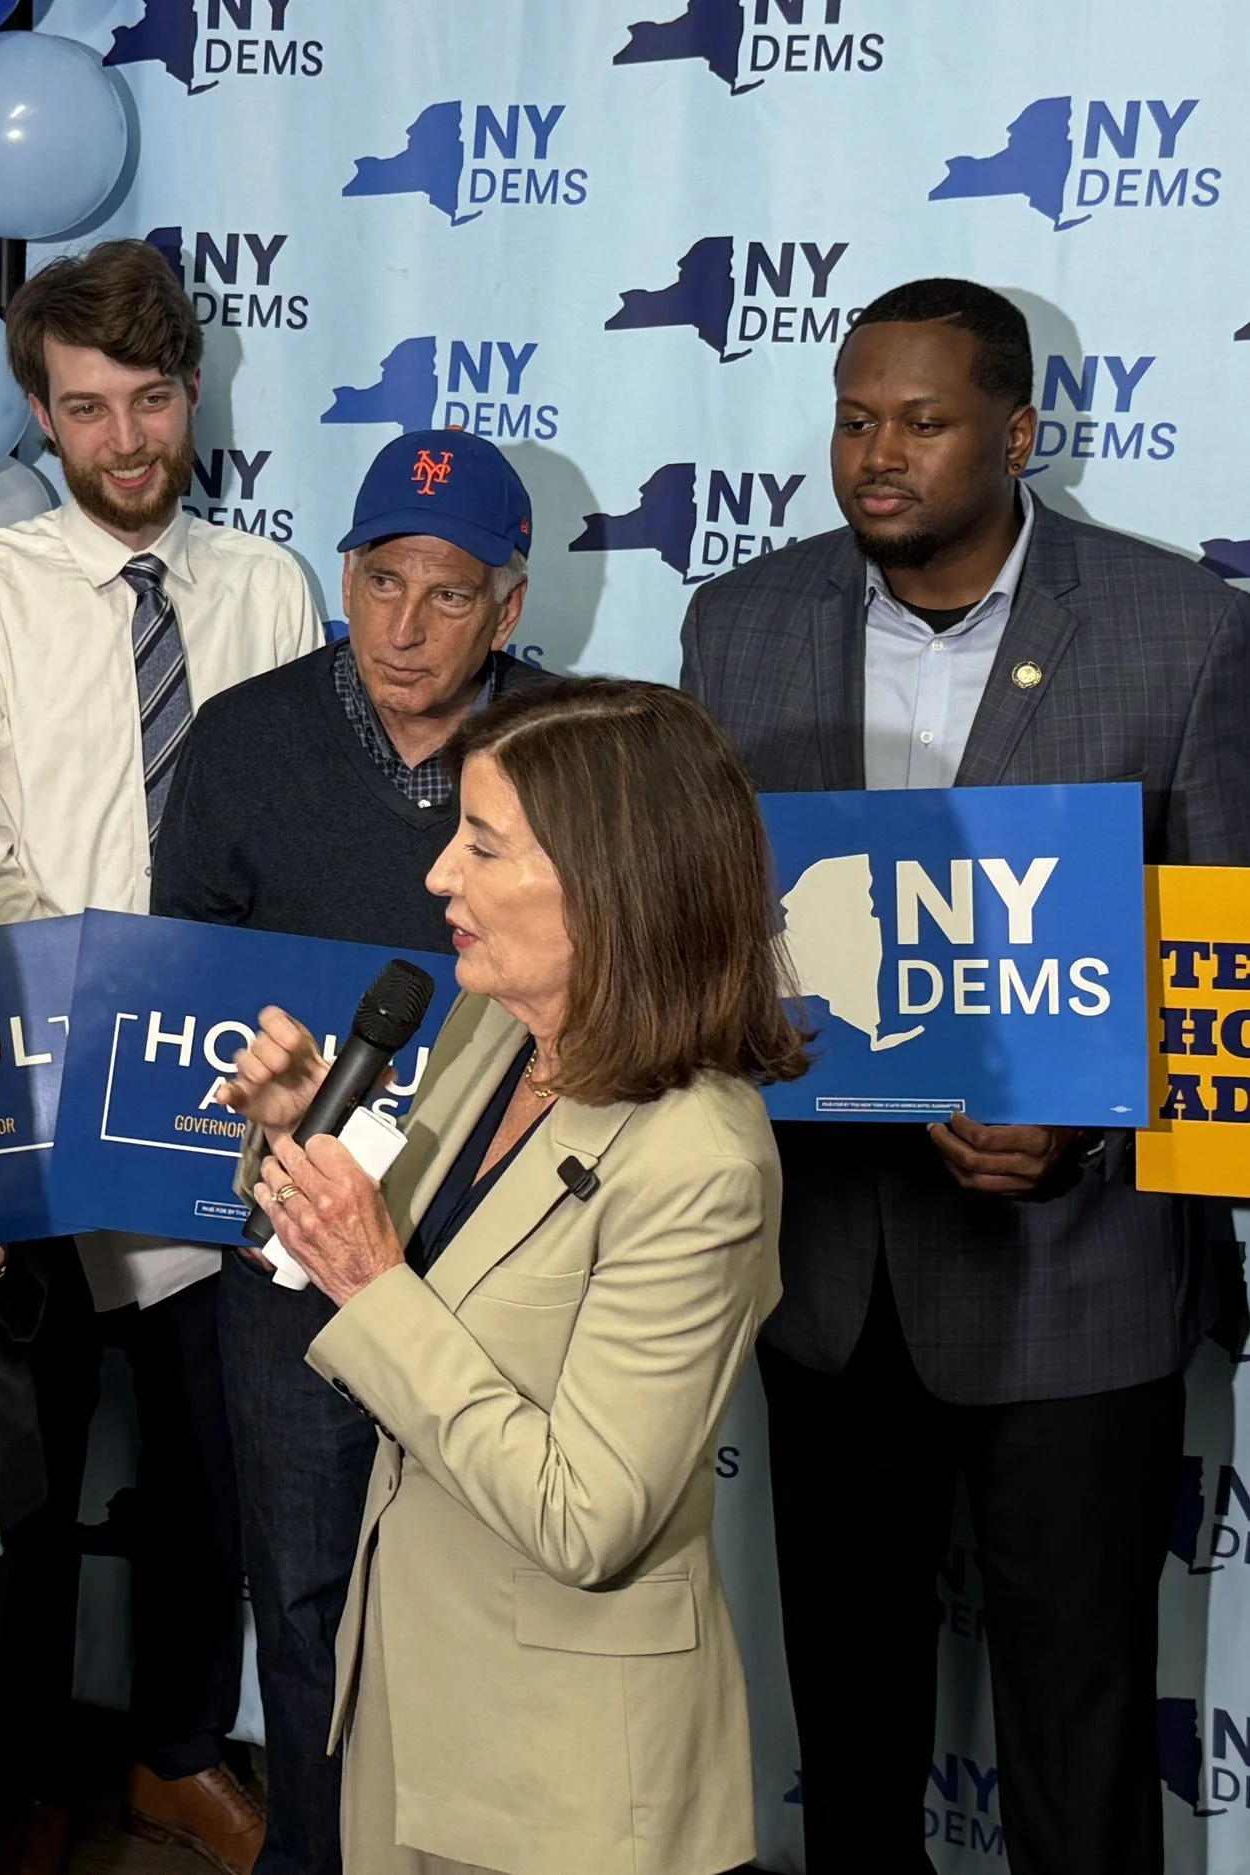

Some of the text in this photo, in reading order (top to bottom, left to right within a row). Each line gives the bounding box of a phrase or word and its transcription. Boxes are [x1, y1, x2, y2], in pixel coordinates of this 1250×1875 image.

[205, 38, 323, 77] DEMS
[750, 33, 885, 73] DEMS
[472, 105, 566, 160] NY
[1082, 99, 1200, 160] NY
[469, 168, 588, 206] DEMS
[1076, 168, 1222, 208] DEMS
[193, 231, 288, 286] NY
[744, 241, 850, 298] NY
[192, 291, 309, 330] DEMS
[447, 340, 539, 395] NY
[1041, 355, 1157, 413] NY
[444, 401, 559, 440] DEMS
[1034, 420, 1177, 460] DEMS
[180, 449, 272, 500] NY
[411, 450, 453, 495] NY
[705, 469, 807, 527] NY
[702, 530, 797, 568] DE
[896, 857, 1059, 945] NY
[897, 957, 1111, 1017] DEMS
[174, 1114, 247, 1139] GOVERNOR
[925, 1807, 1004, 1857] DEM
